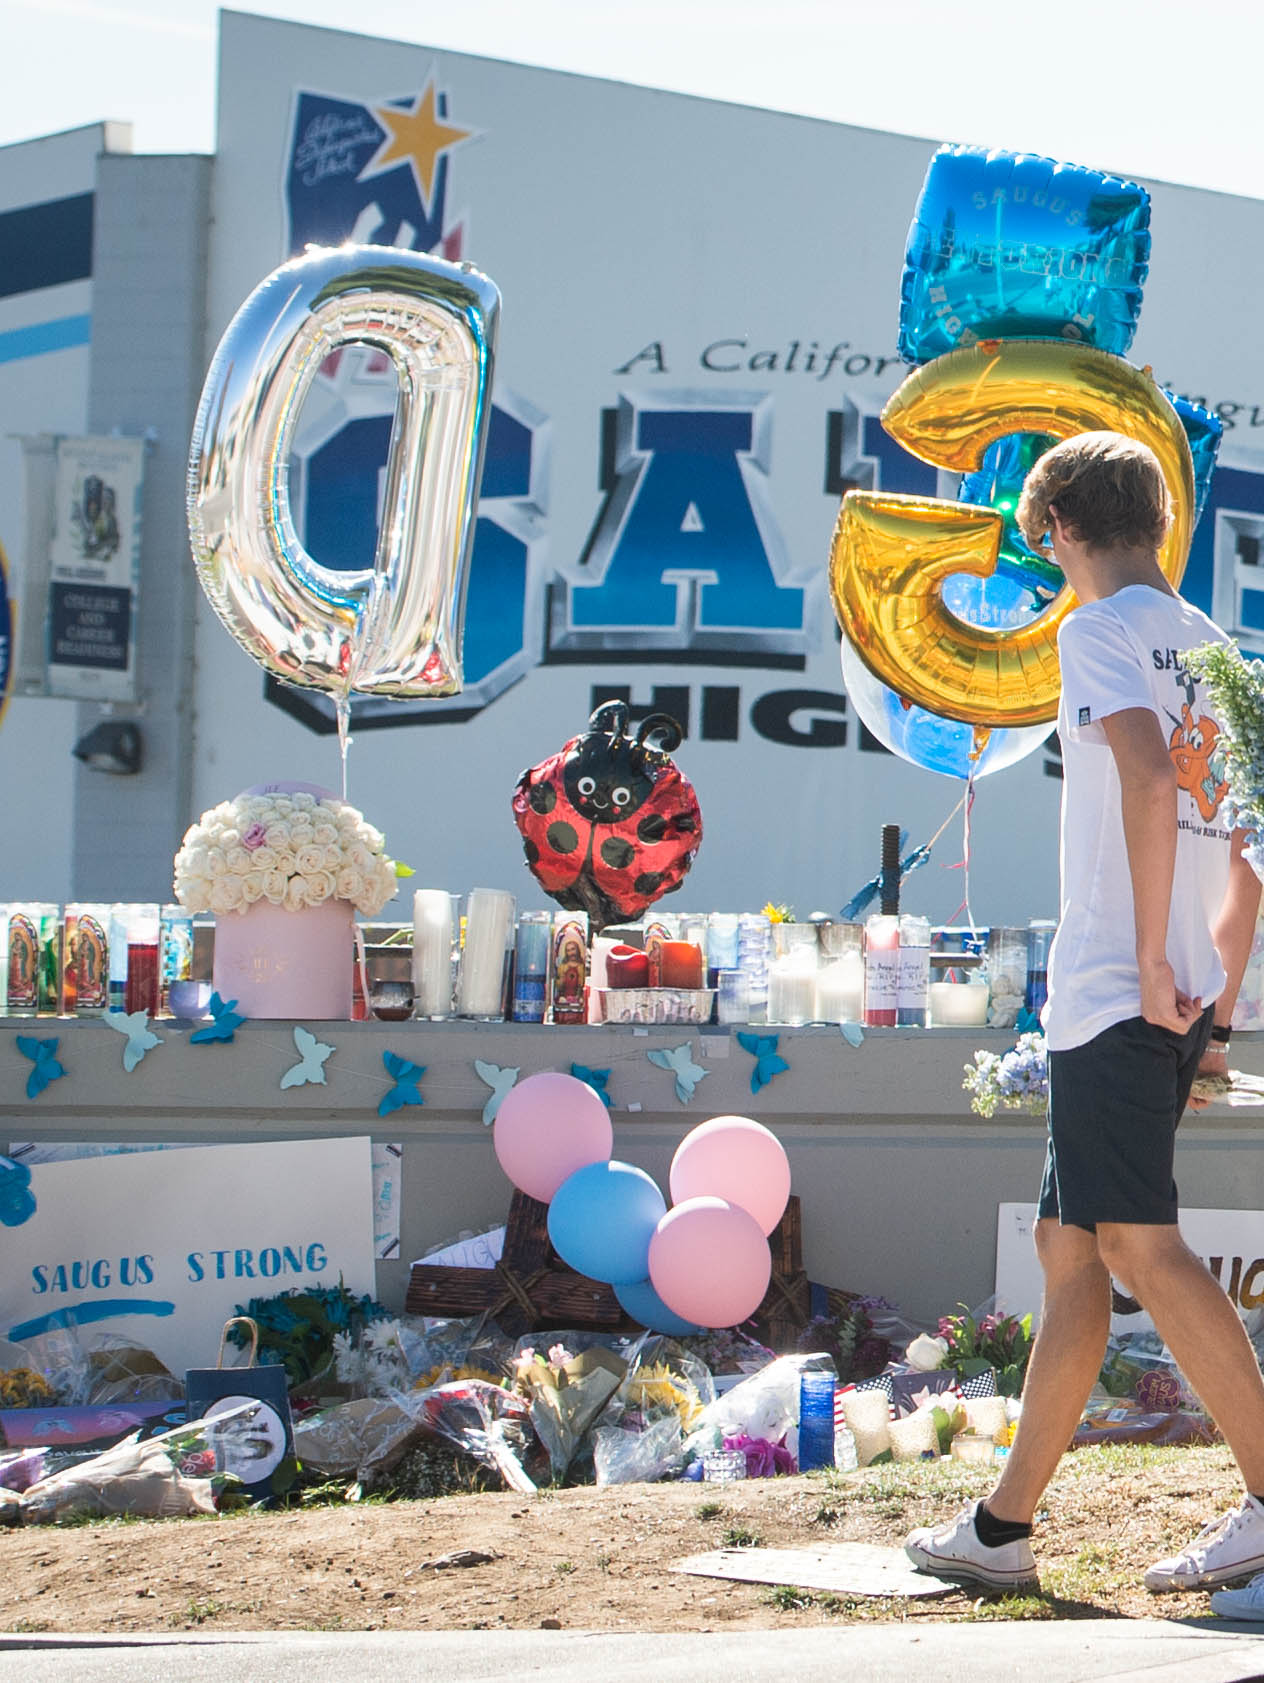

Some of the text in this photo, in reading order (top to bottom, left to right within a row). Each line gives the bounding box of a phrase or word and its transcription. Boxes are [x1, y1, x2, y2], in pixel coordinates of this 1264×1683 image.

[613, 338, 669, 376] A
[700, 337, 914, 383] Califor
[31, 1242, 329, 1295] SAUGUS STRONG
